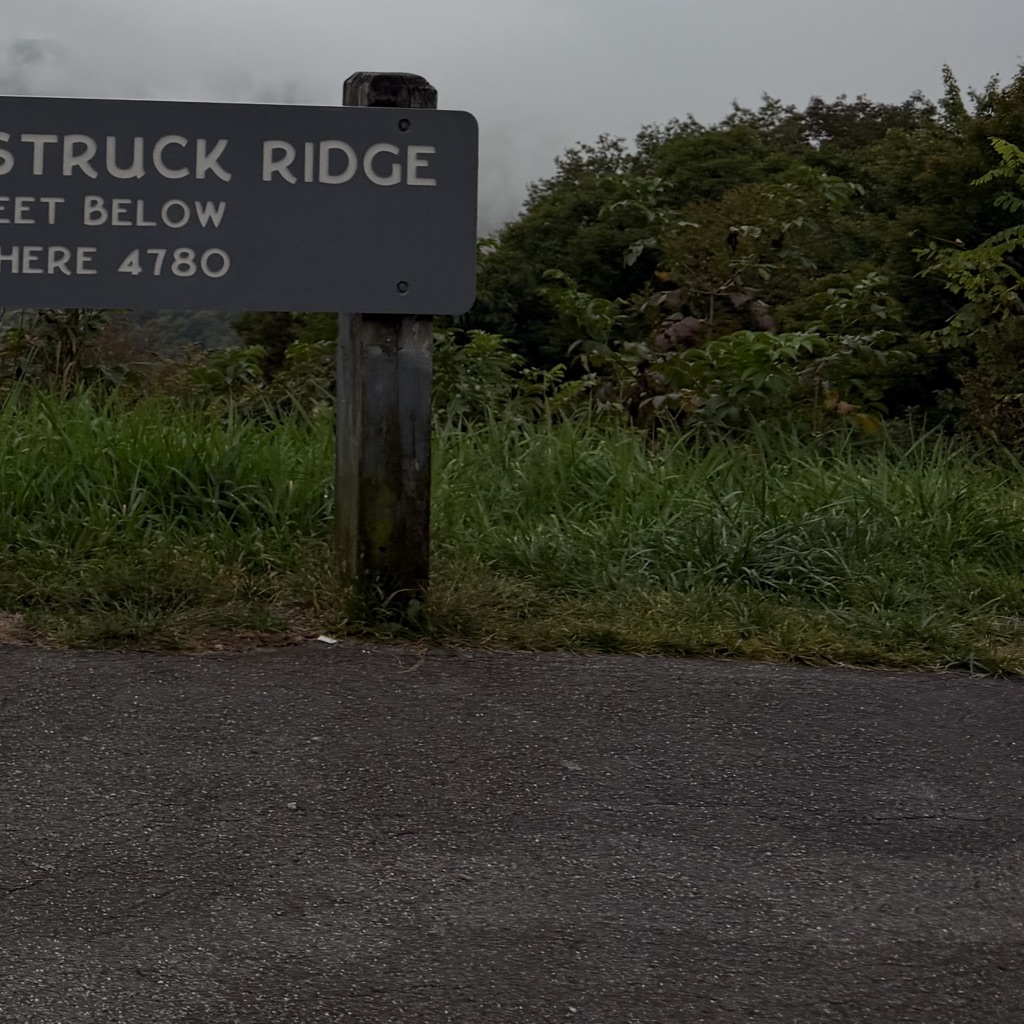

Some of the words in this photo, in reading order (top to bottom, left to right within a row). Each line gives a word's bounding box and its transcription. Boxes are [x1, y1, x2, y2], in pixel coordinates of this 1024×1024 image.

[262, 140, 437, 189] RIDGE
[83, 195, 226, 229] BELOW
[117, 247, 231, 278] 4780
